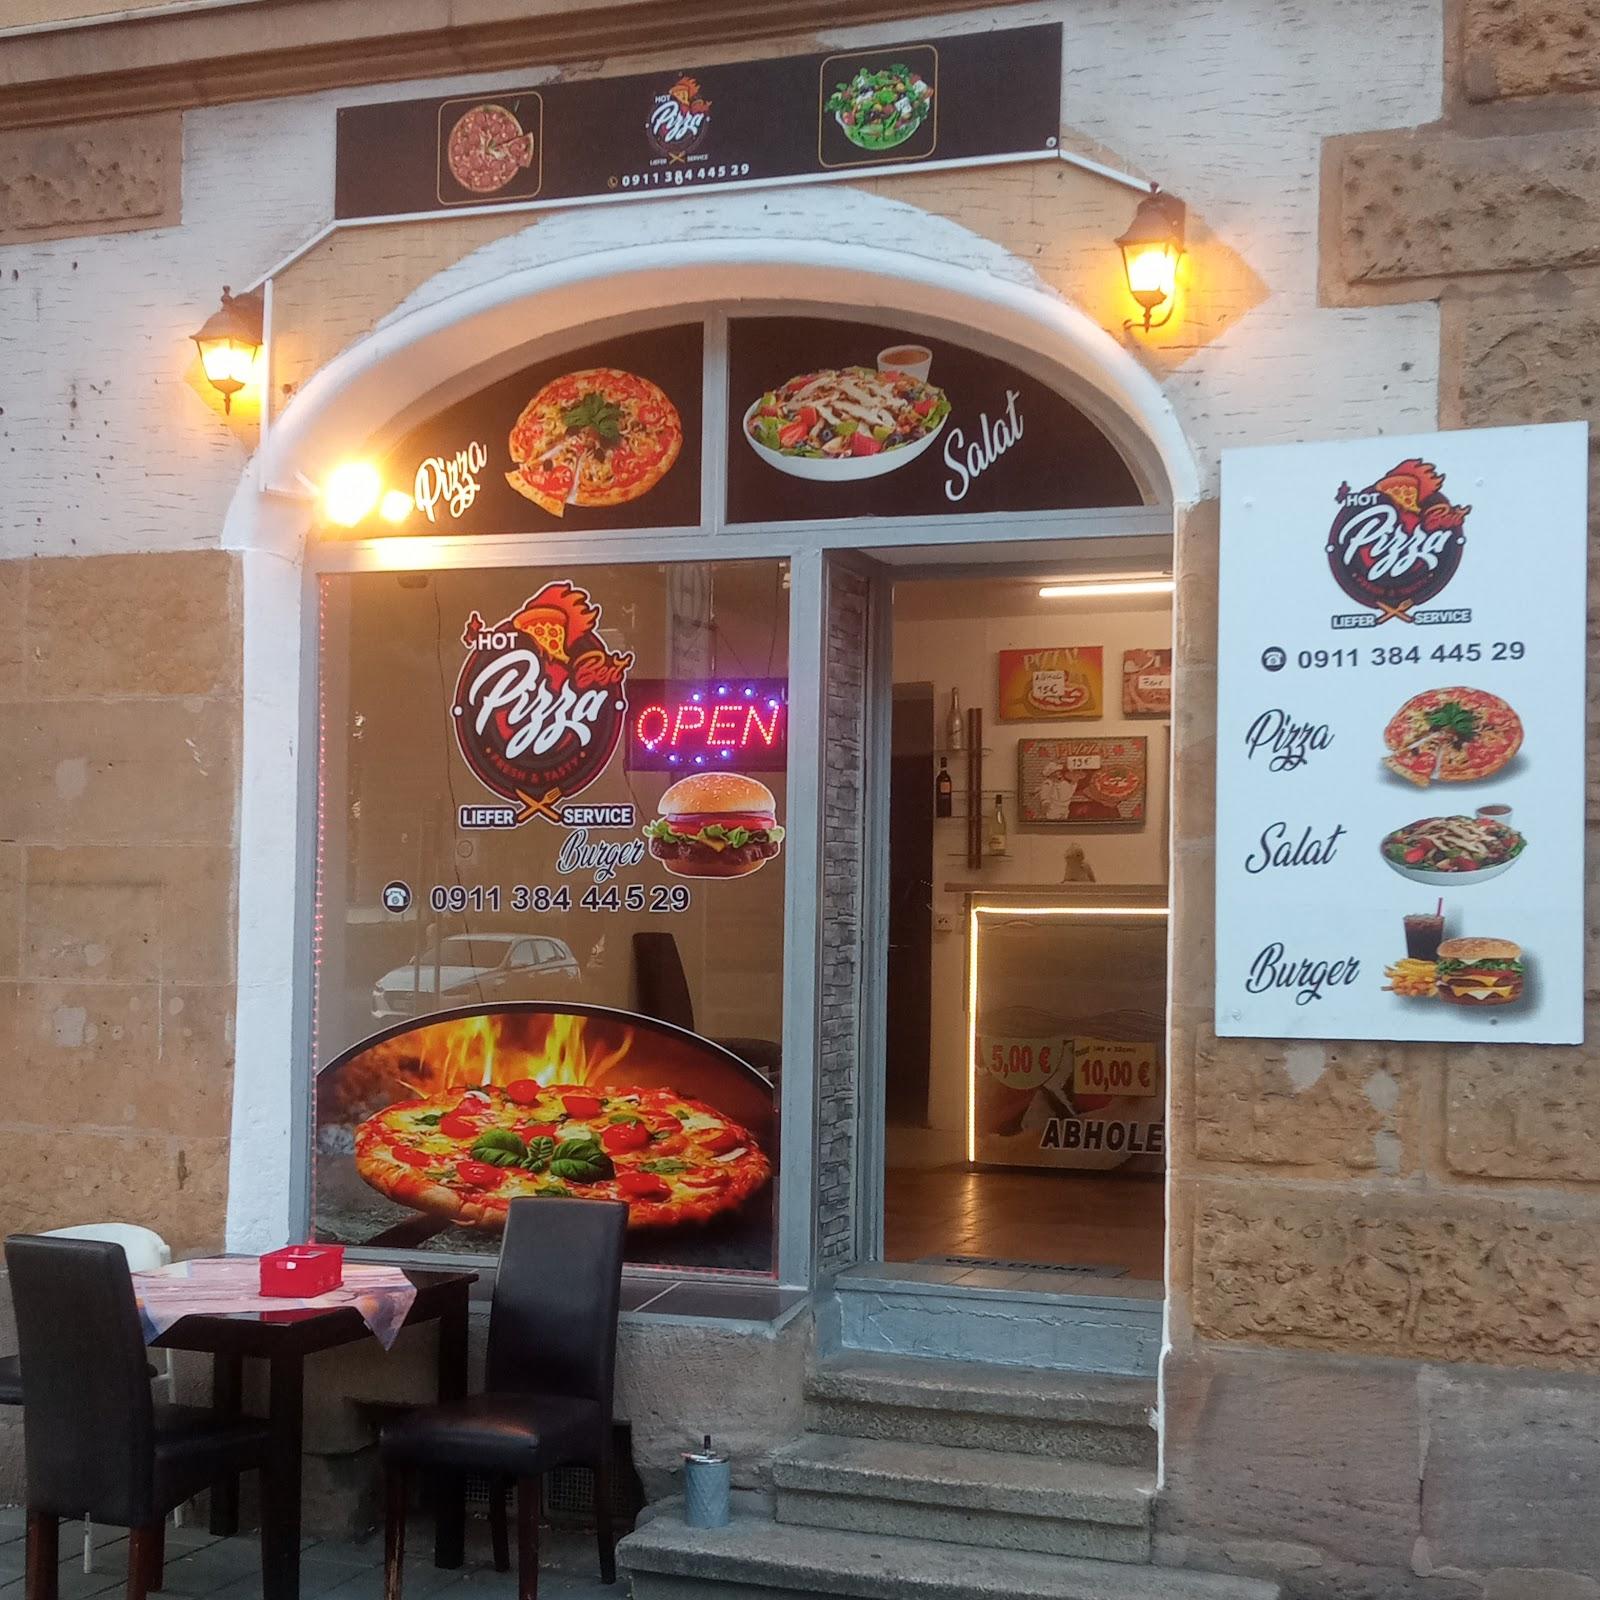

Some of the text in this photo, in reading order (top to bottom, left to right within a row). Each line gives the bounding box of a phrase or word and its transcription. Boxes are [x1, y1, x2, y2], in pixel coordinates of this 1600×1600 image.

[655, 95, 671, 104] HOT
[651, 101, 705, 142] Pizza
[622, 172, 660, 187] 0911
[665, 168, 694, 184] 384
[944, 388, 1027, 502] Salat
[413, 440, 489, 523] Pizza
[1346, 493, 1380, 507] HOT
[1339, 504, 1453, 581] Pizza
[1333, 610, 1471, 628] LIEFER SERVICE
[478, 632, 519, 651] HOT
[1297, 641, 1525, 669] 0911 384 445 29
[469, 649, 609, 759] Pizza
[636, 704, 781, 748] OPEN
[1245, 709, 1335, 772] Pizza
[462, 806, 632, 825] LIEFER SERVICE
[557, 828, 645, 882] Burger
[1245, 821, 1347, 874] Salat
[430, 885, 500, 912] 0911
[512, 885, 571, 912] 384
[1246, 942, 1360, 1006] Burger
[991, 1044, 1051, 1078] 5,00 €
[1080, 1059, 1150, 1092] 10,00 €
